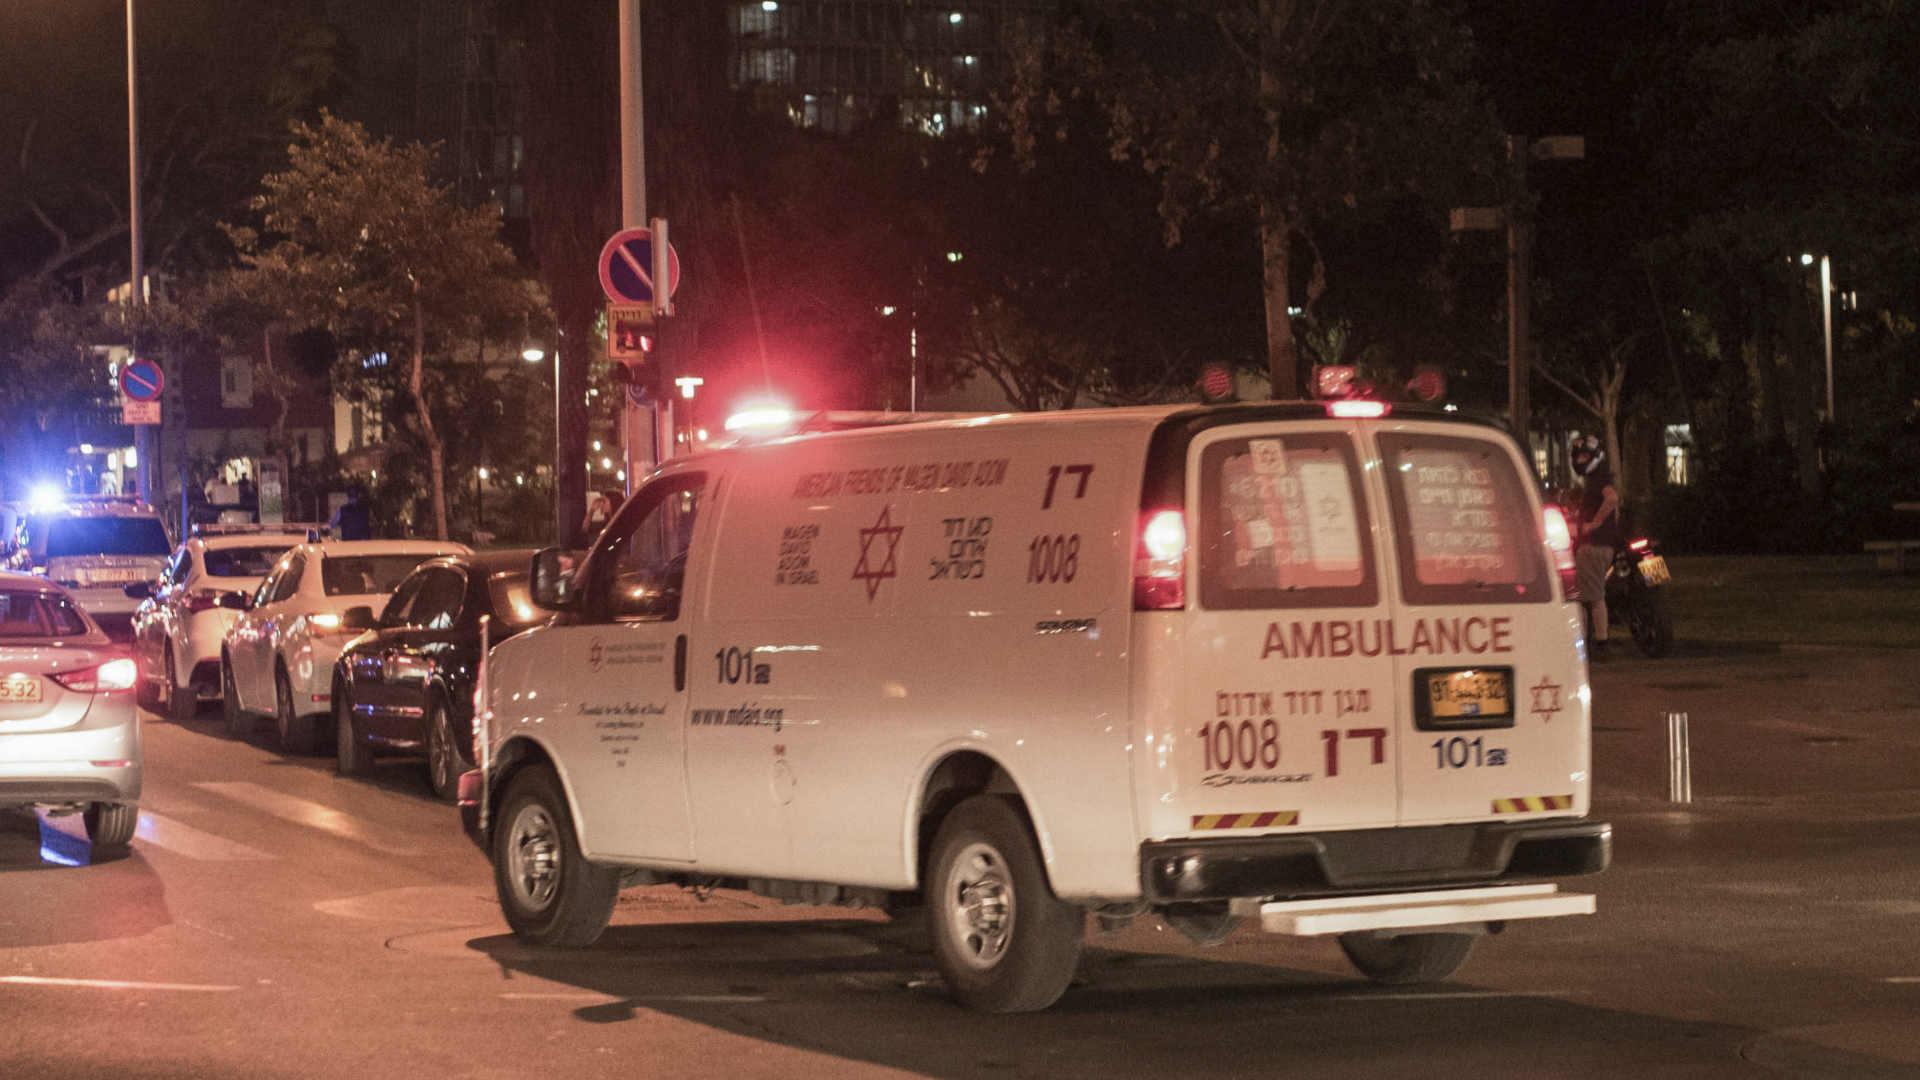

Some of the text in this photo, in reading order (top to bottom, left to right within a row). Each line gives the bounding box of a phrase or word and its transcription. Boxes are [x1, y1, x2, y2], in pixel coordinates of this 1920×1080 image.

[1042, 463, 1095, 511] דן
[1026, 533, 1081, 585] 1008
[1260, 617, 1514, 660] AMBULANCE
[715, 646, 753, 684] 101
[1216, 689, 1371, 718] מגן דוד אדום
[1198, 718, 1281, 771] 1008
[1321, 727, 1388, 777] דן
[1431, 736, 1486, 769] 101
